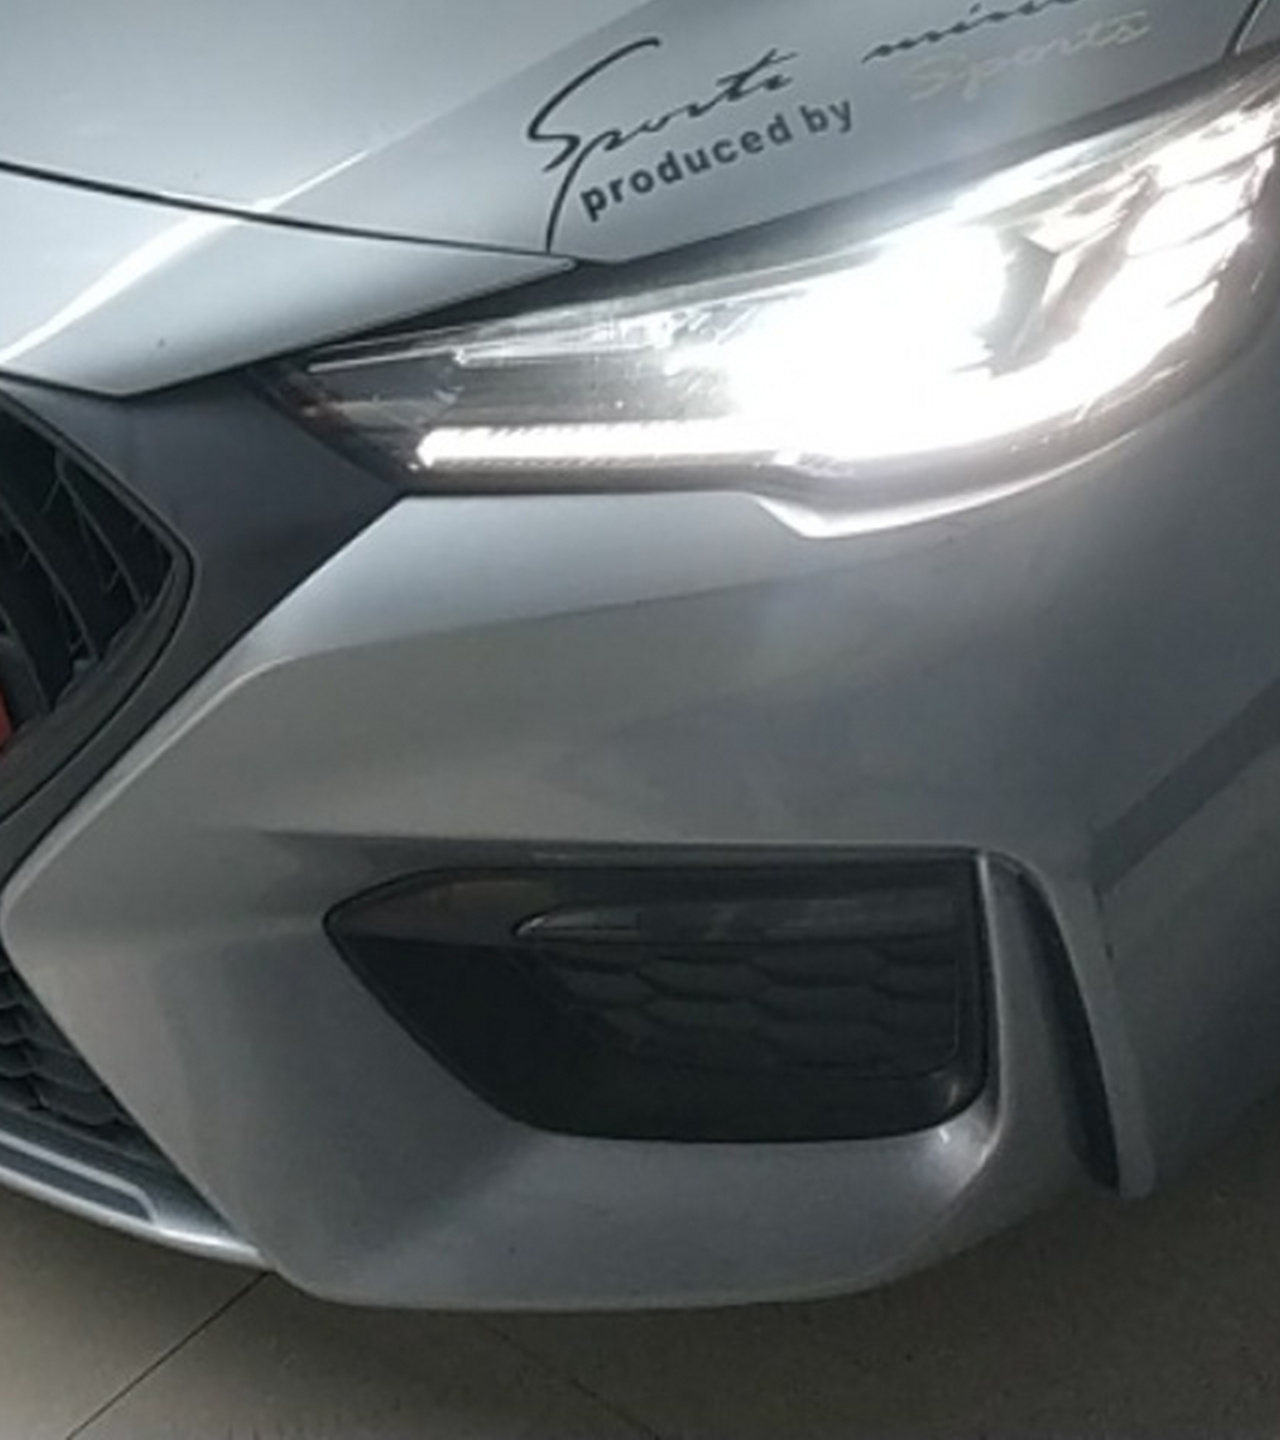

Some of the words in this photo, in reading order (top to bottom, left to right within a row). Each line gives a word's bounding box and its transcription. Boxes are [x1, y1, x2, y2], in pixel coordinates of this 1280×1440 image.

[526, 36, 798, 254] Sports
[579, 113, 794, 223] produced
[799, 99, 854, 134] by
